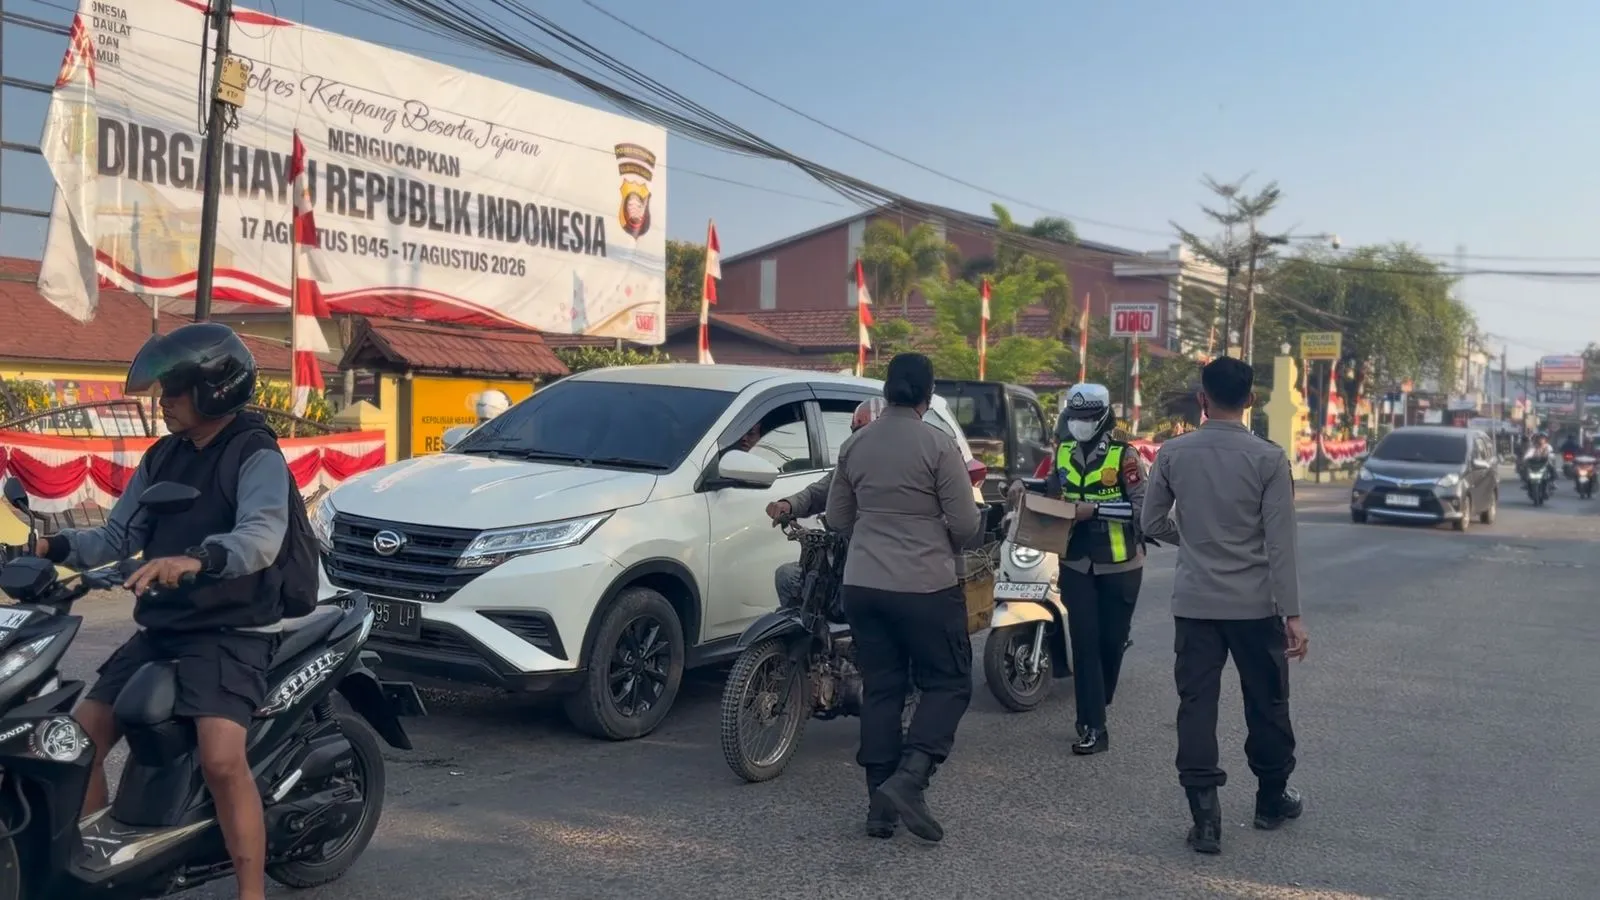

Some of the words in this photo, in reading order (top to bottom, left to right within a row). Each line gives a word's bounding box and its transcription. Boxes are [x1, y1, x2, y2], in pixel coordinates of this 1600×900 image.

[93, 17, 131, 36] DAULAT
[98, 34, 119, 49] DAN
[240, 58, 295, 98] olres
[300, 75, 398, 134] Ketapang
[402, 100, 474, 143] Beserta
[474, 122, 542, 160] Jajaran
[328, 128, 460, 178] MENGUCAPKAN
[326, 162, 472, 236] REPUBLIK
[478, 192, 607, 257] INDONESIA
[240, 216, 259, 240] 17
[262, 219, 348, 253] AGTUS
[351, 234, 389, 259] 1945
[402, 241, 417, 261] 17
[419, 243, 488, 273] AGUSTUS
[491, 254, 526, 277] 2026
[280, 652, 333, 700] STREET
